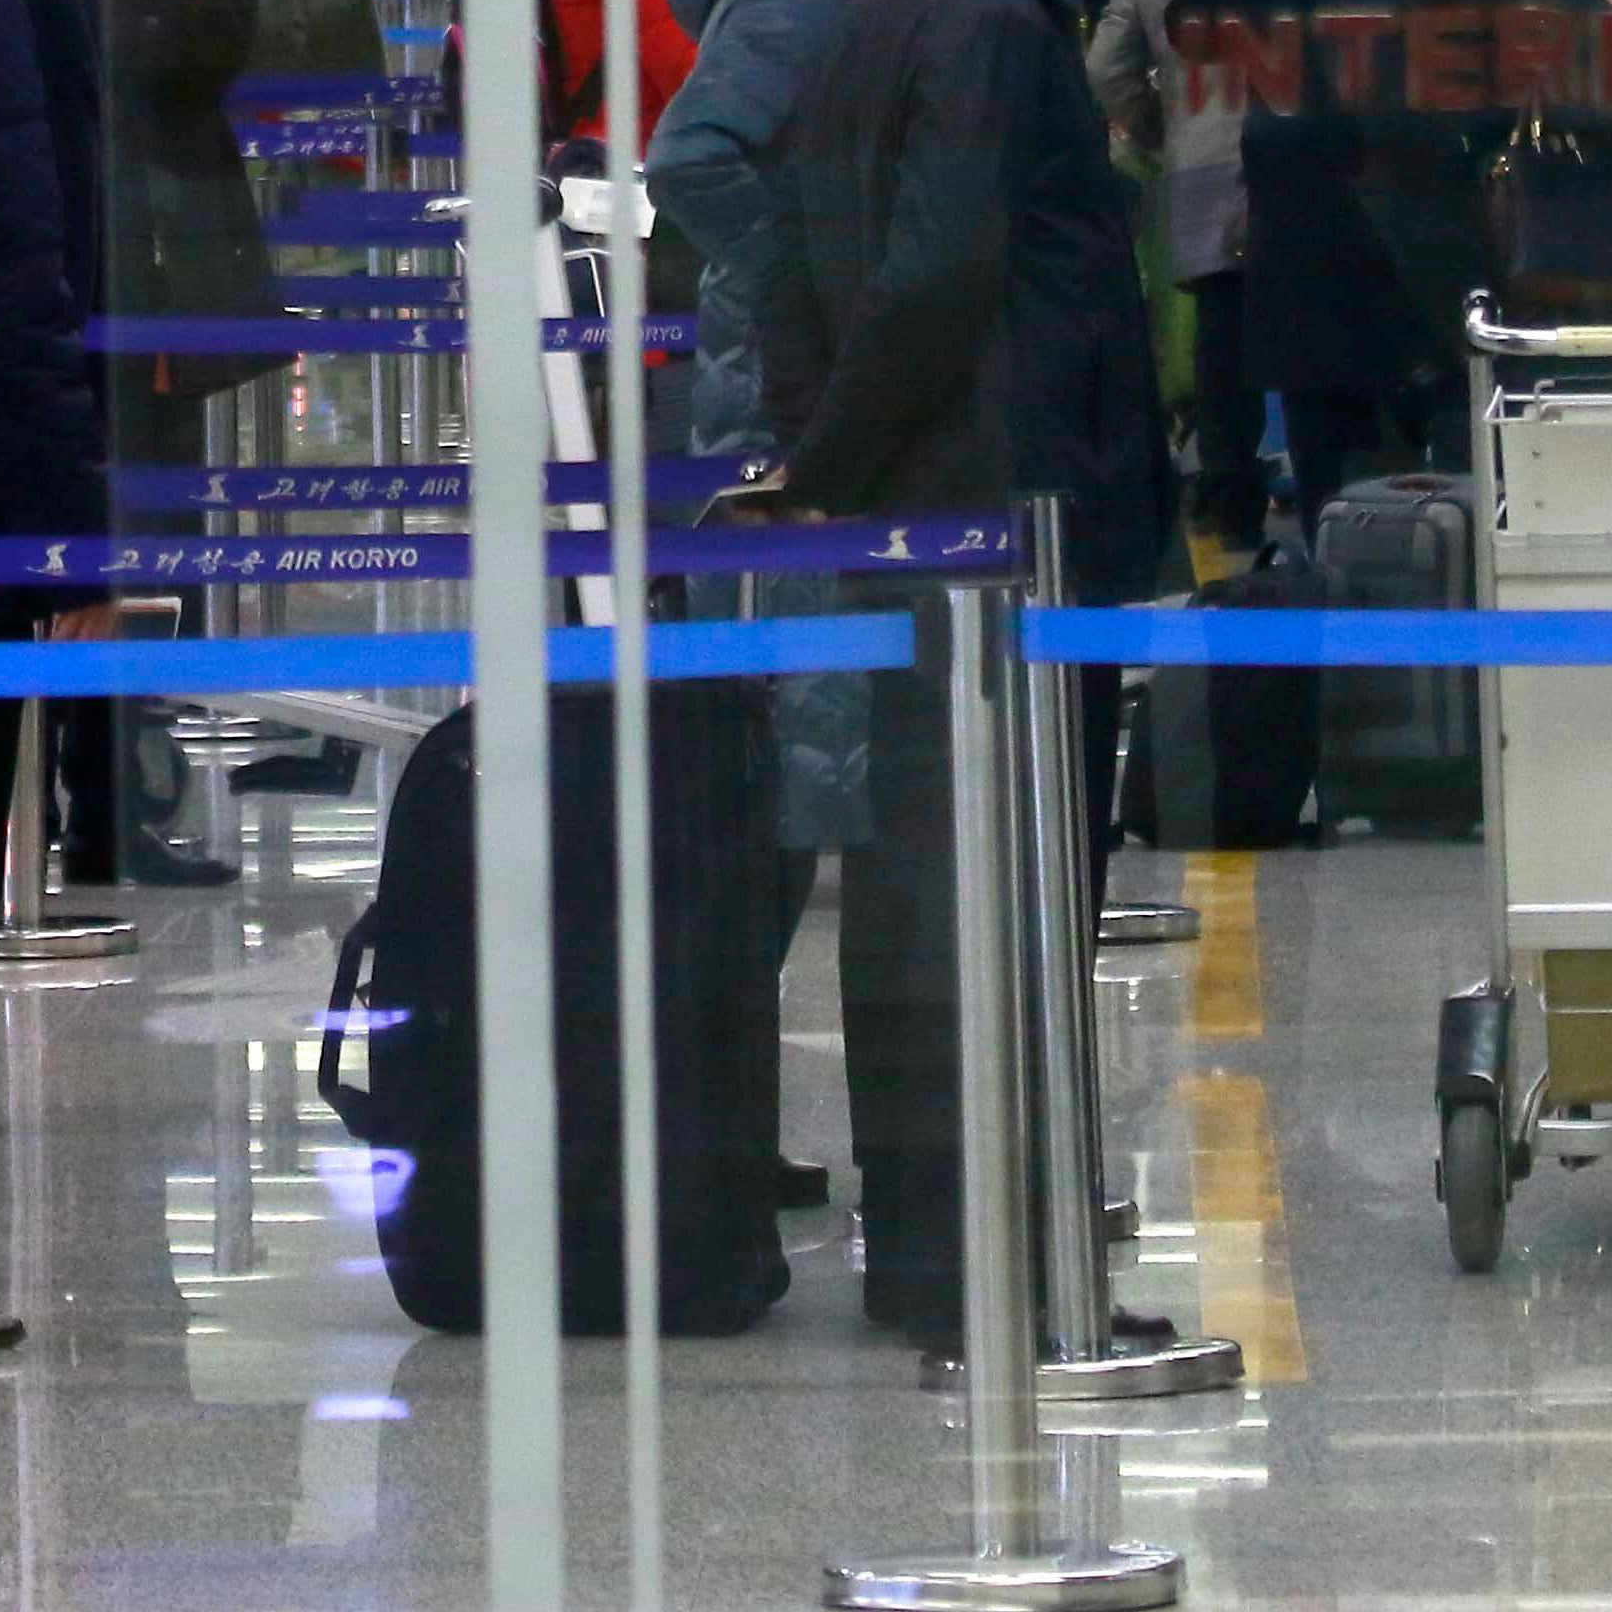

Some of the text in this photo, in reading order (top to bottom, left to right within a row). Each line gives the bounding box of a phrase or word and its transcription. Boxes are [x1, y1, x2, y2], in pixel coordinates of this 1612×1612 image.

[418, 477, 461, 497] AIR
[274, 549, 322, 572] AIR
[329, 547, 419, 571] KORYO
